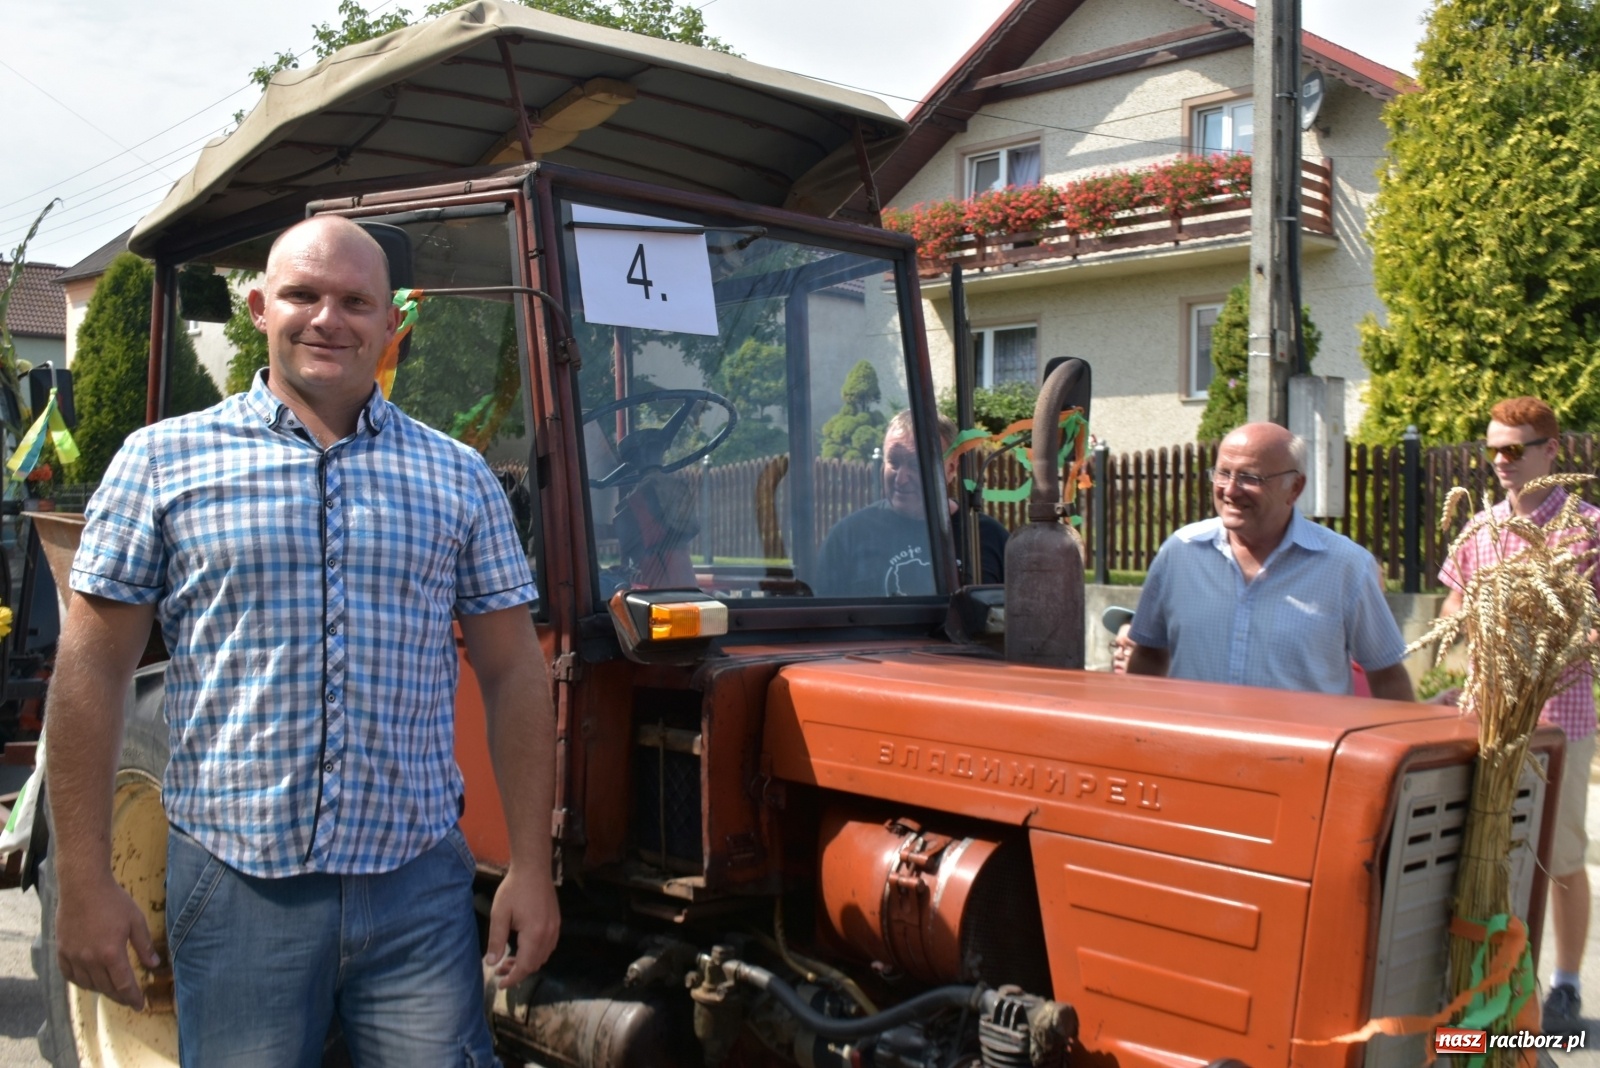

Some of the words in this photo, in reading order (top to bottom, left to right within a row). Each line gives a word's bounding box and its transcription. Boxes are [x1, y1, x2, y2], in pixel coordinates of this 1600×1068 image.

[626, 243, 668, 302] 4.
[889, 545, 922, 566] moje
[877, 741, 1162, 811] ВЛАДИМИРЕЦ
